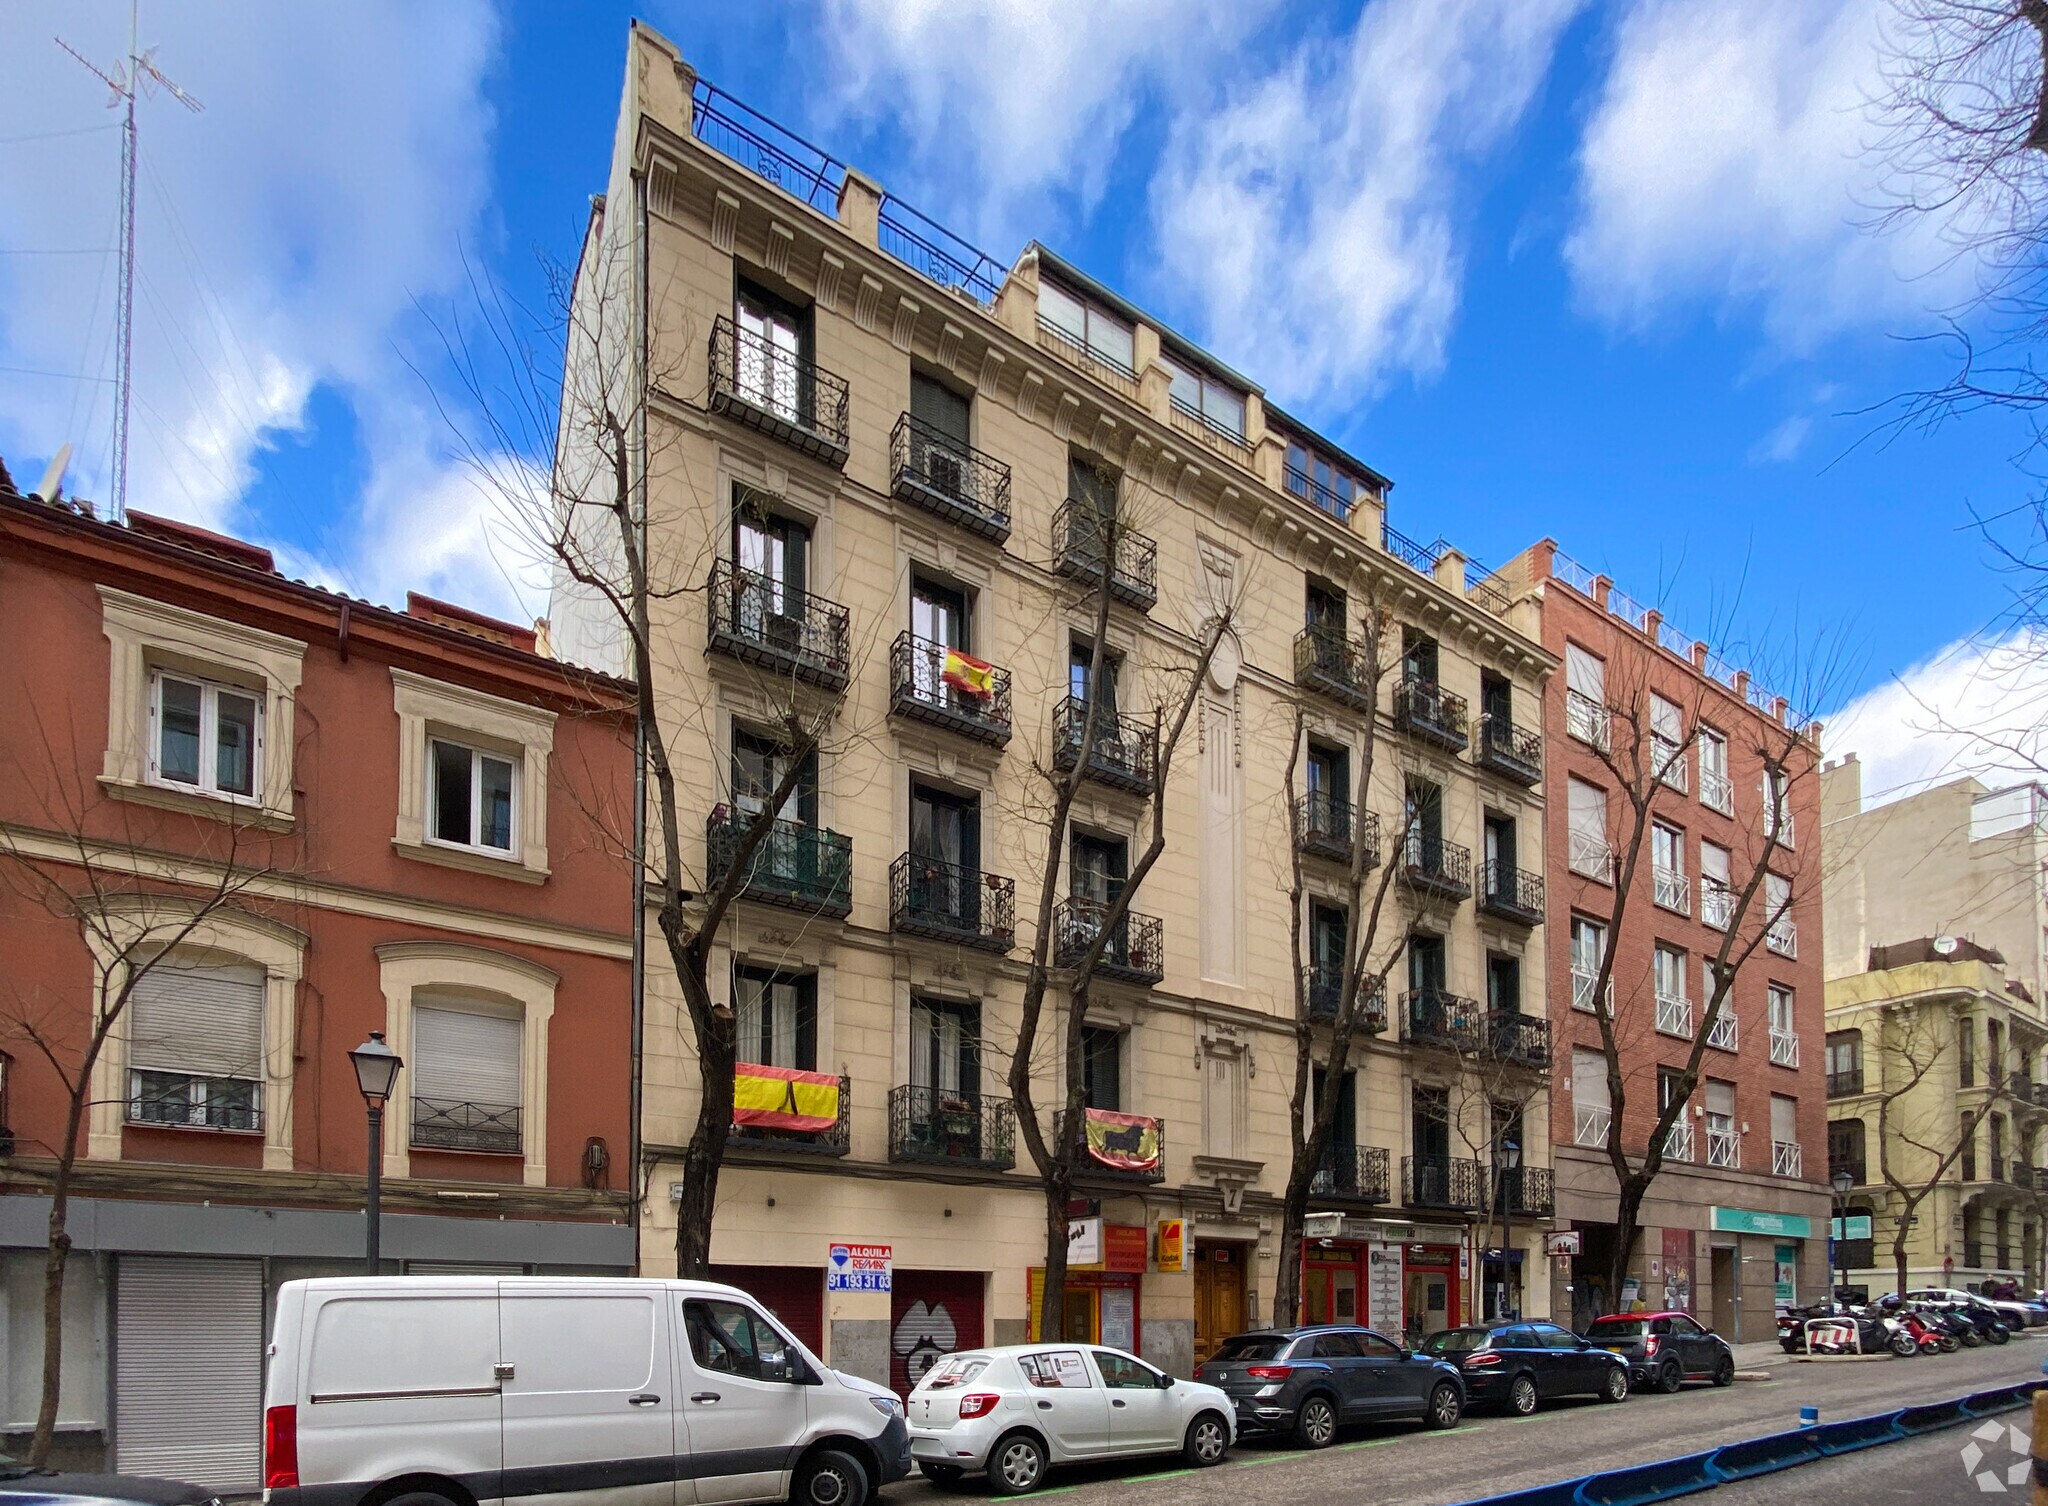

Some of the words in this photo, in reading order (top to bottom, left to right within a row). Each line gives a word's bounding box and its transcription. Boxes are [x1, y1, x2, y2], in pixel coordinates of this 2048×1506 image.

[1229, 1189, 1237, 1207] 7
[851, 1247, 891, 1258] ALQUILA
[1161, 1253, 1179, 1262] Kodak
[852, 1259, 886, 1270] RE/MAX
[829, 1274, 841, 1288] 91
[844, 1275, 863, 1288] 193
[864, 1276, 876, 1289] 31
[879, 1276, 891, 1290] 03
